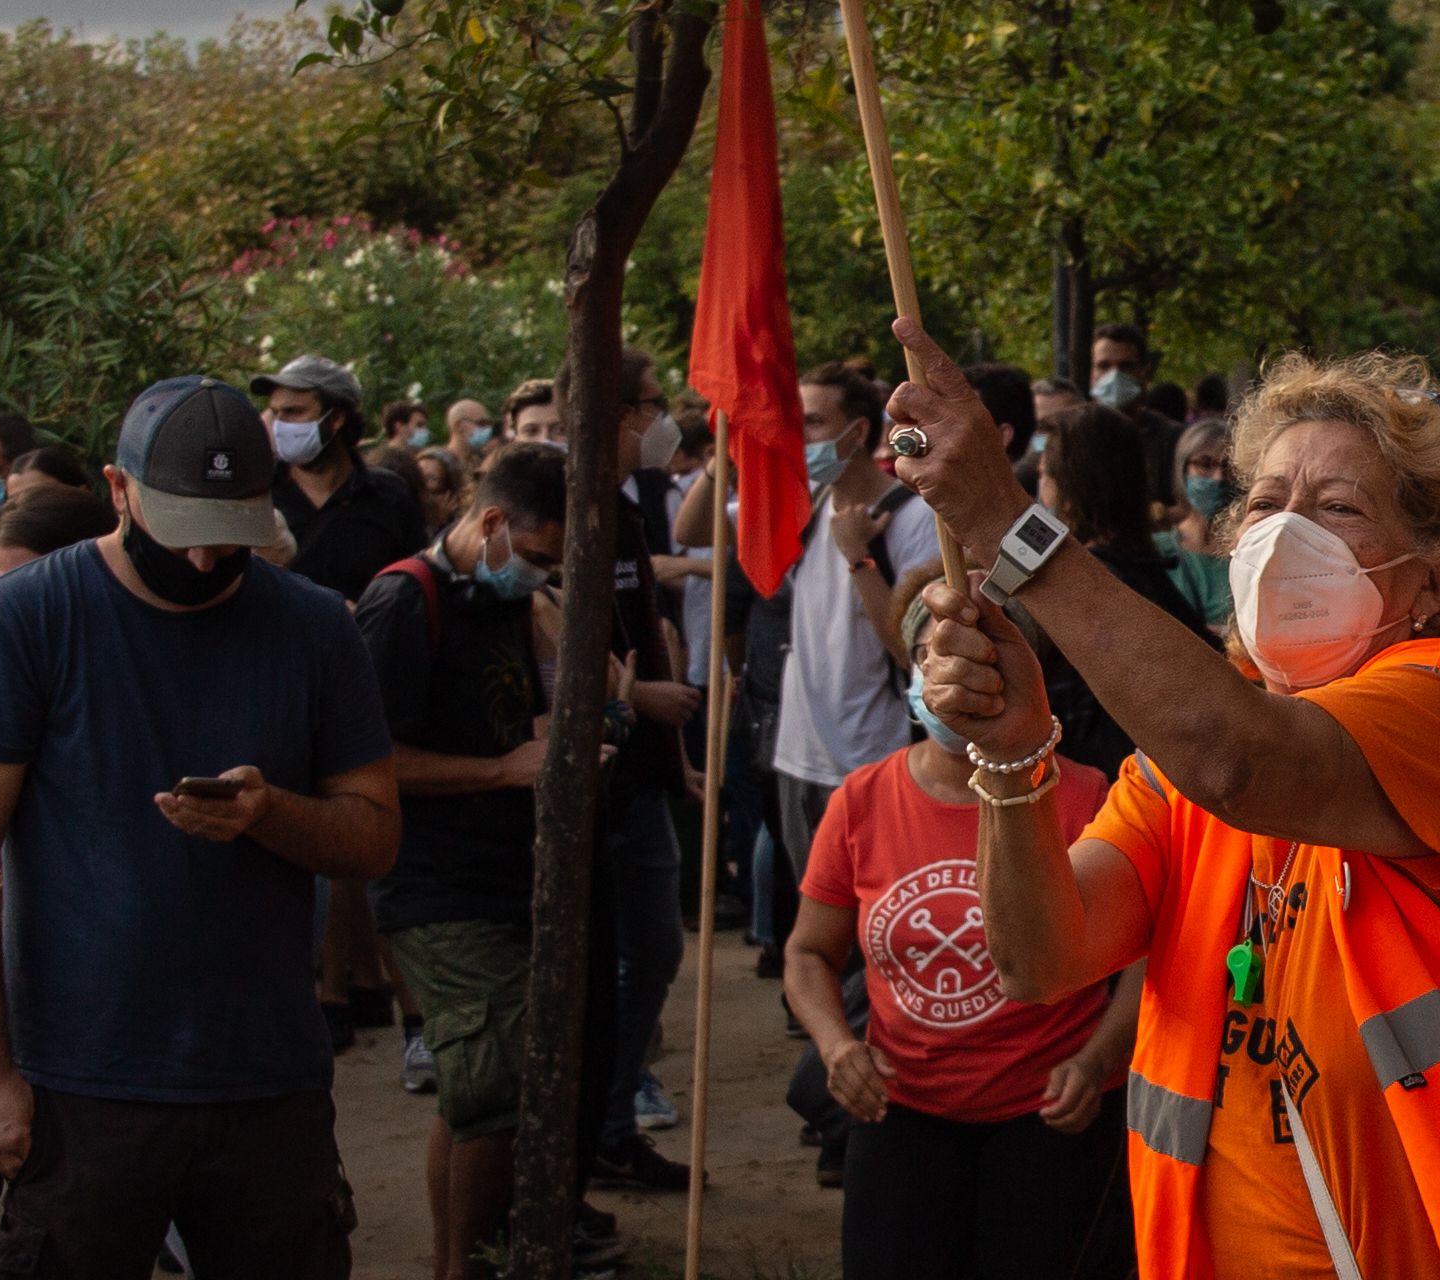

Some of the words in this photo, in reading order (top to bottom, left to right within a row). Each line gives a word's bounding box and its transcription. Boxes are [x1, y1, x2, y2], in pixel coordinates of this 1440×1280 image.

[870, 879, 921, 962] SINDICAT
[926, 869, 953, 889] DE
[895, 978, 925, 1013] ENS
[930, 982, 1006, 1020] QUEDE
